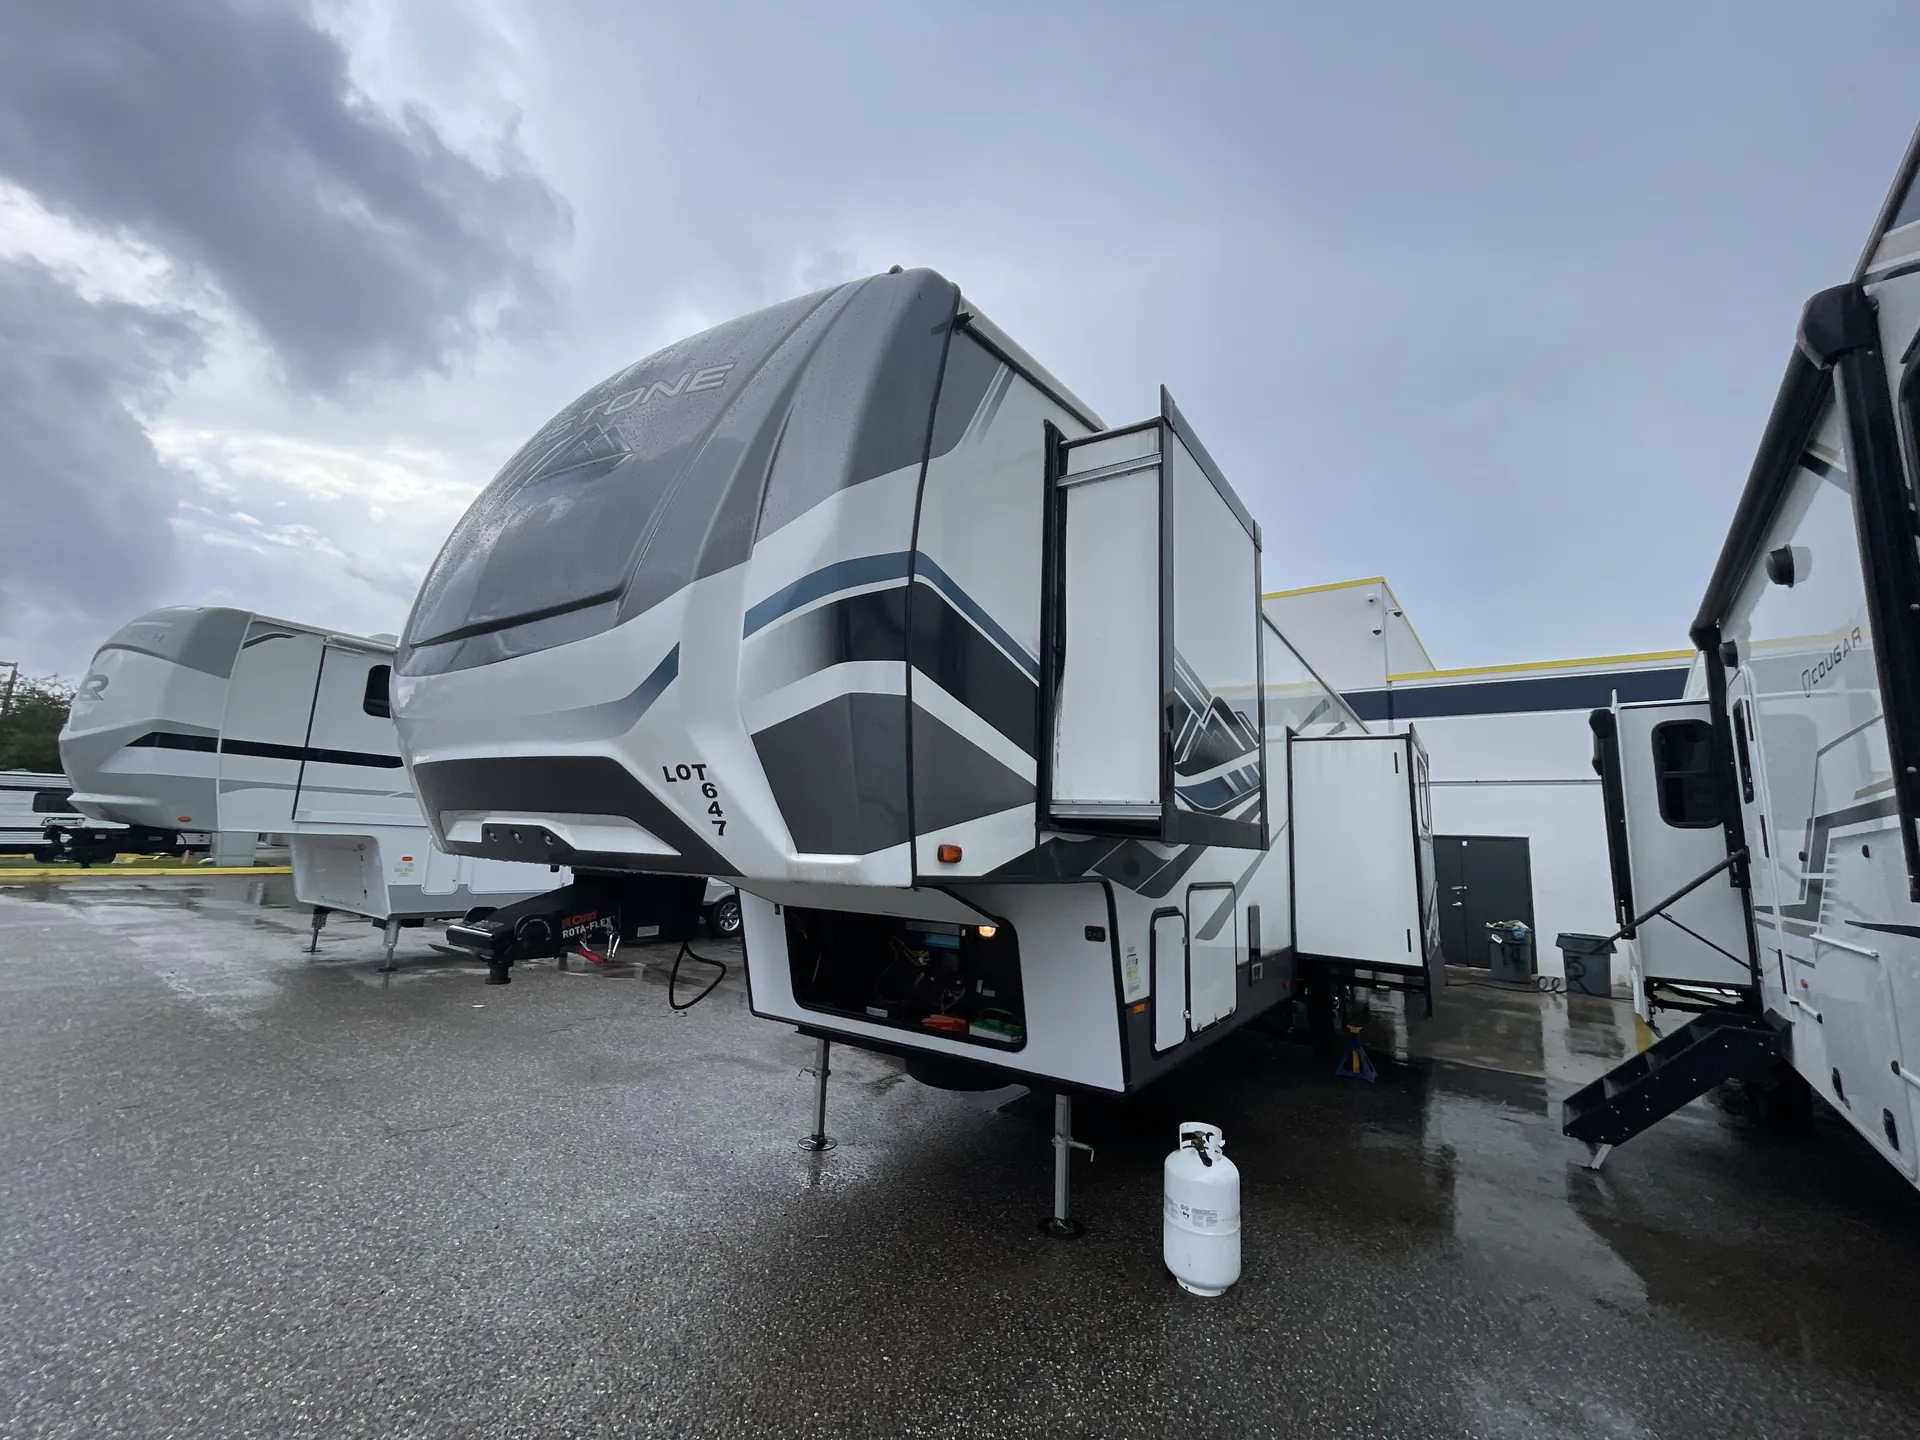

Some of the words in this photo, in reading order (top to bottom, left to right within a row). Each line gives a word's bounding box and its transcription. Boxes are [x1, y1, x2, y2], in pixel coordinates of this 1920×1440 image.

[1811, 626, 1862, 685] COUGAR
[662, 763, 707, 783] LOT
[562, 916, 613, 939] ROTA-FLEX
